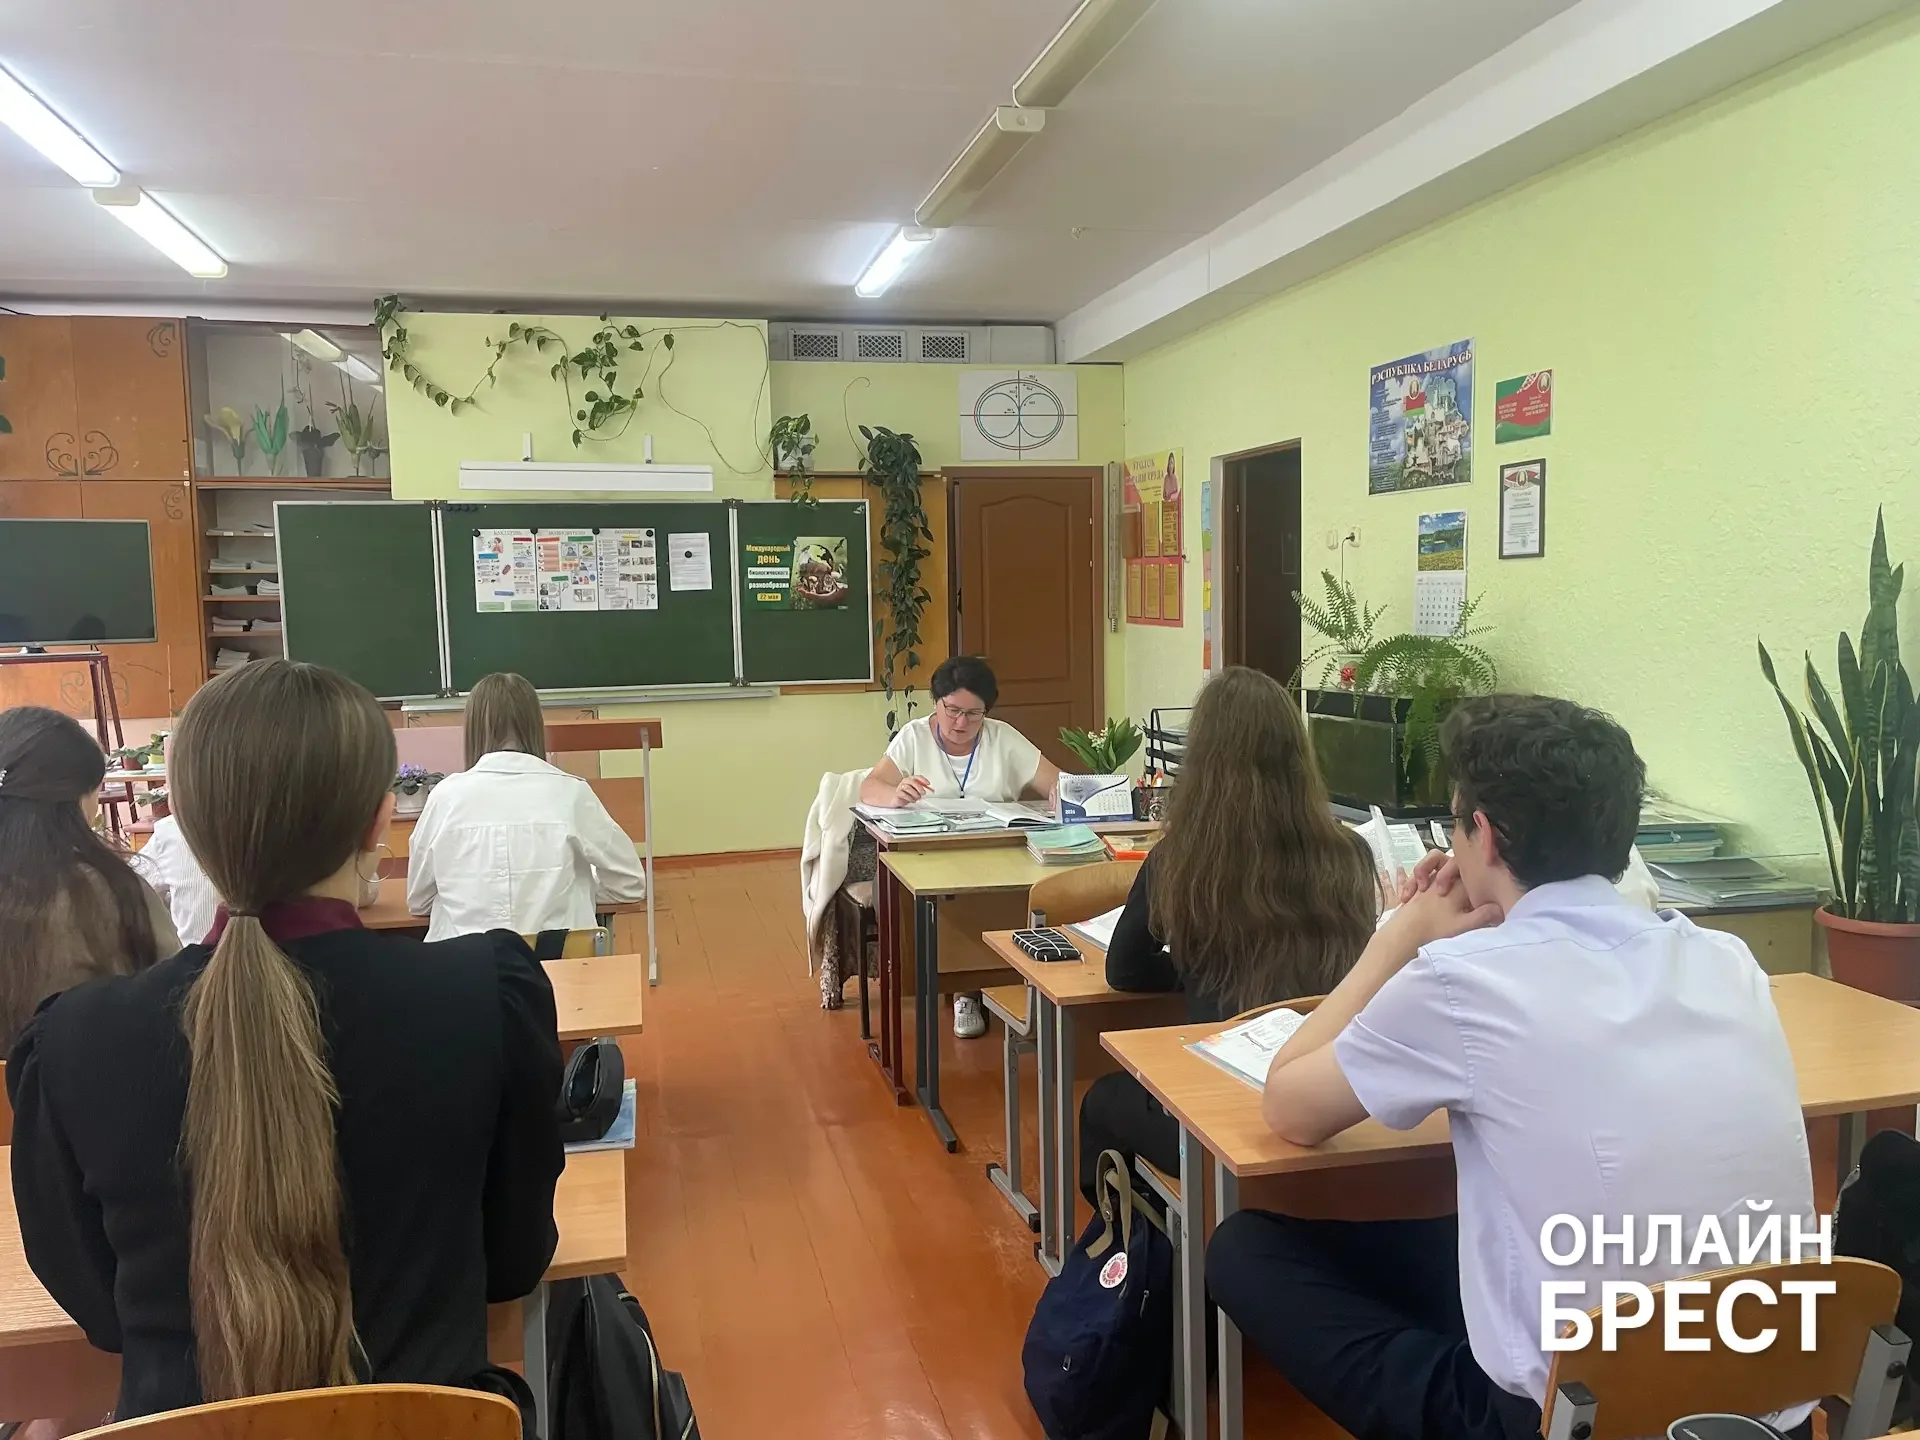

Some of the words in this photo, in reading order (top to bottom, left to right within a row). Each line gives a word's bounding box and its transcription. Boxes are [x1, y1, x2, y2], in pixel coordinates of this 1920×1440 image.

[1371, 363, 1422, 385] РЭСПУБЛІКА
[1423, 349, 1472, 373] БЕЛАРУСЬ
[745, 544, 791, 553] Международный
[748, 581, 790, 590] разнообразия
